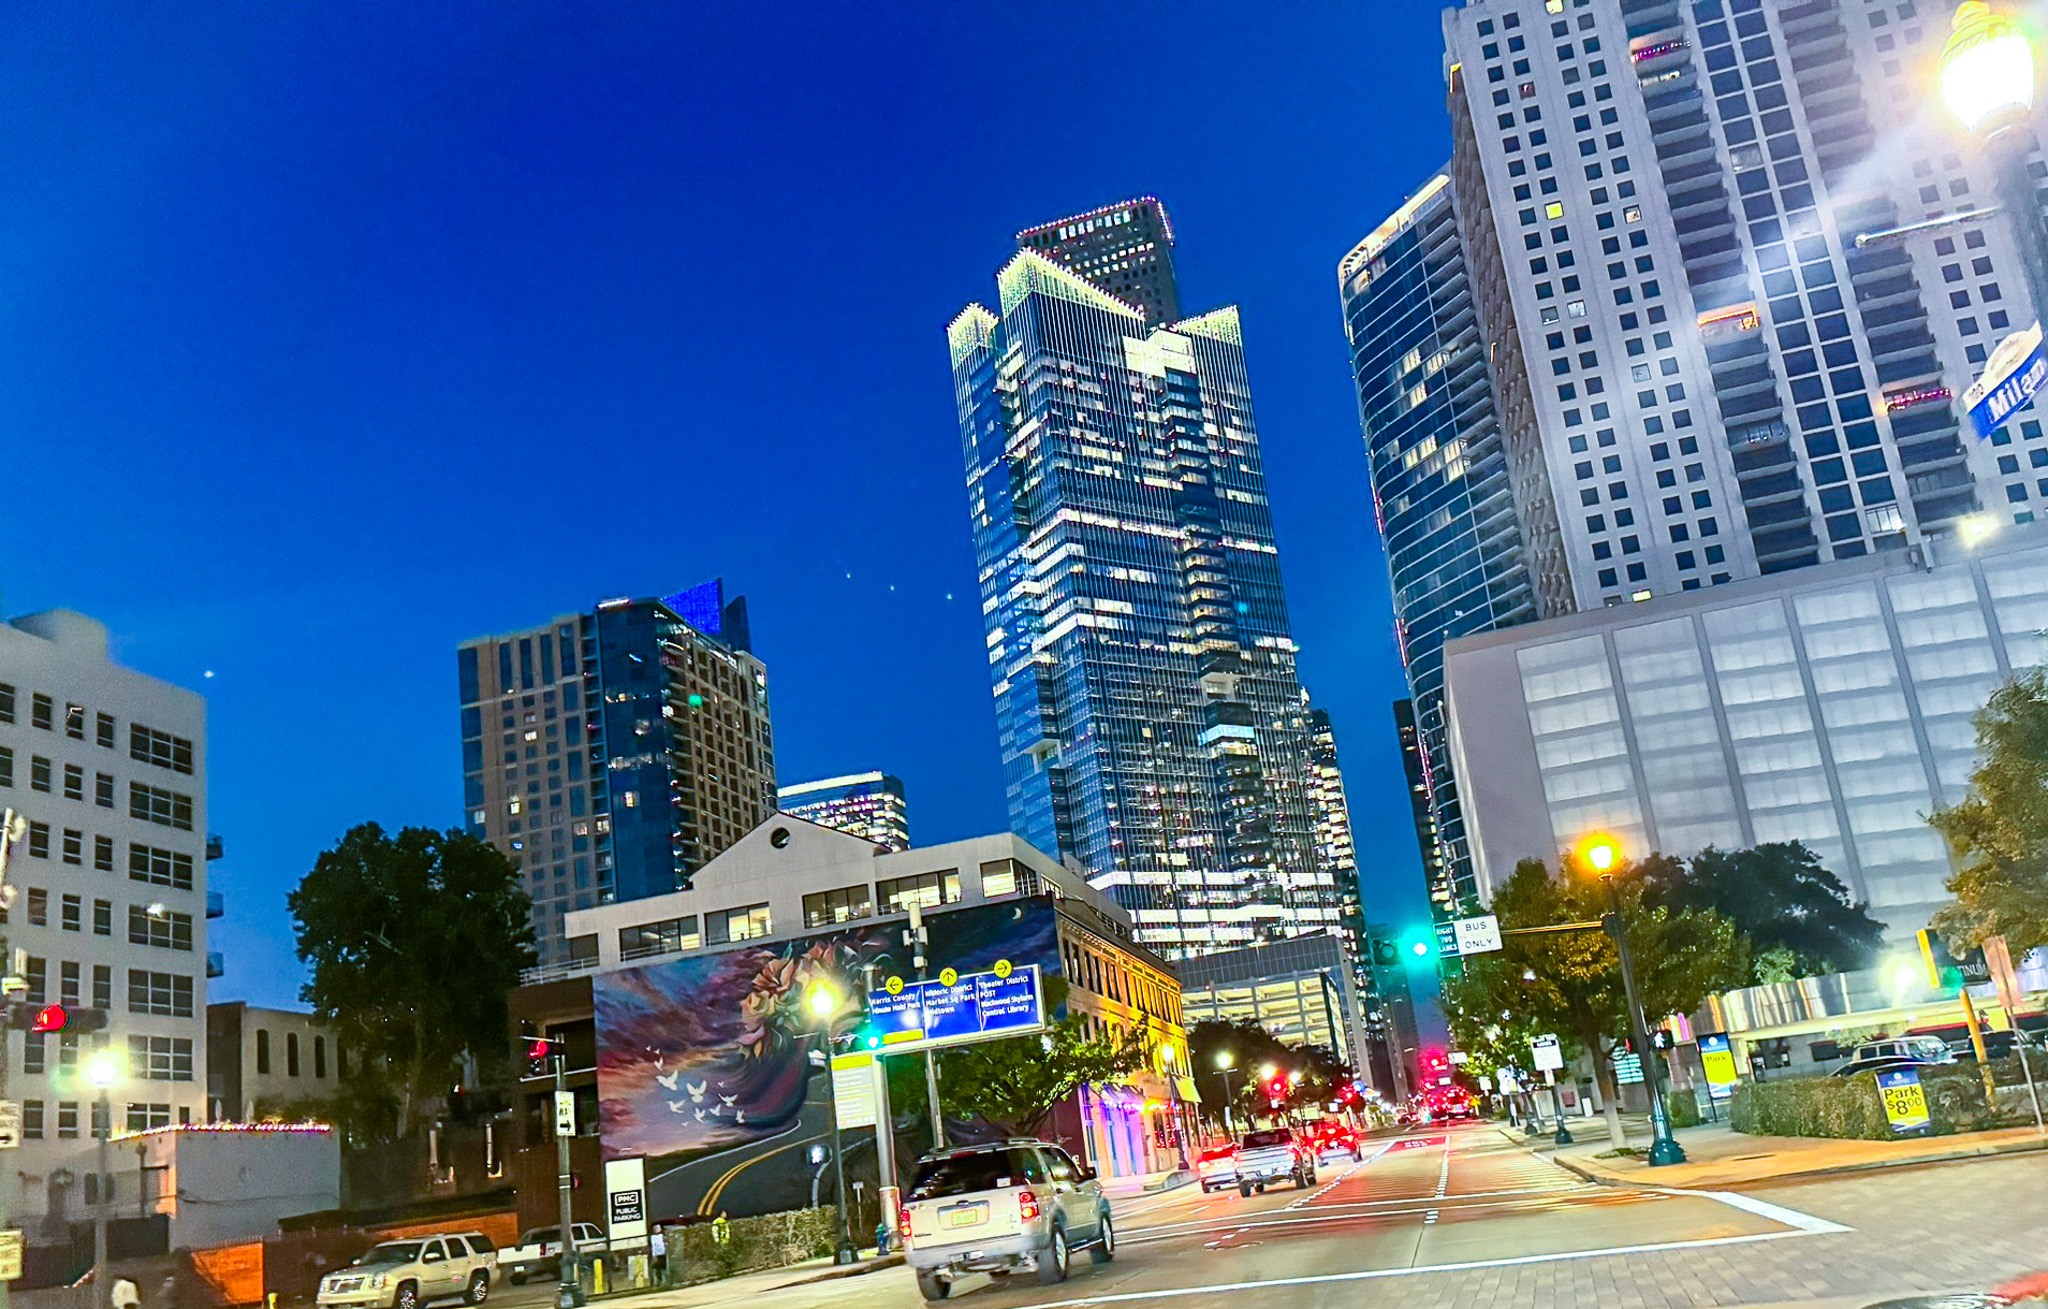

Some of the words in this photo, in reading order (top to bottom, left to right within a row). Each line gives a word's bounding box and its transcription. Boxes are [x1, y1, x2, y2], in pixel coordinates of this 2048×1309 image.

[1465, 921, 1486, 931] BUS
[1440, 935, 1453, 944] TWO
[1465, 938, 1492, 948] ONLY
[1954, 964, 1988, 977] TINUM
[979, 980, 1004, 989] Theater
[1006, 975, 1029, 986] District
[925, 988, 950, 998] Historic
[950, 984, 974, 993] District
[980, 990, 996, 999] POST
[870, 997, 891, 1005] Harris
[925, 997, 949, 1007] Market
[950, 996, 959, 1004] Sq
[960, 993, 976, 1001] Park
[982, 1007, 1005, 1017] Central
[1007, 1004, 1029, 1014] Library
[1884, 1086, 1919, 1100] Park
[617, 1194, 636, 1203] PMC
[615, 1206, 638, 1215] PUBLIC
[613, 1212, 641, 1222] PARKING
